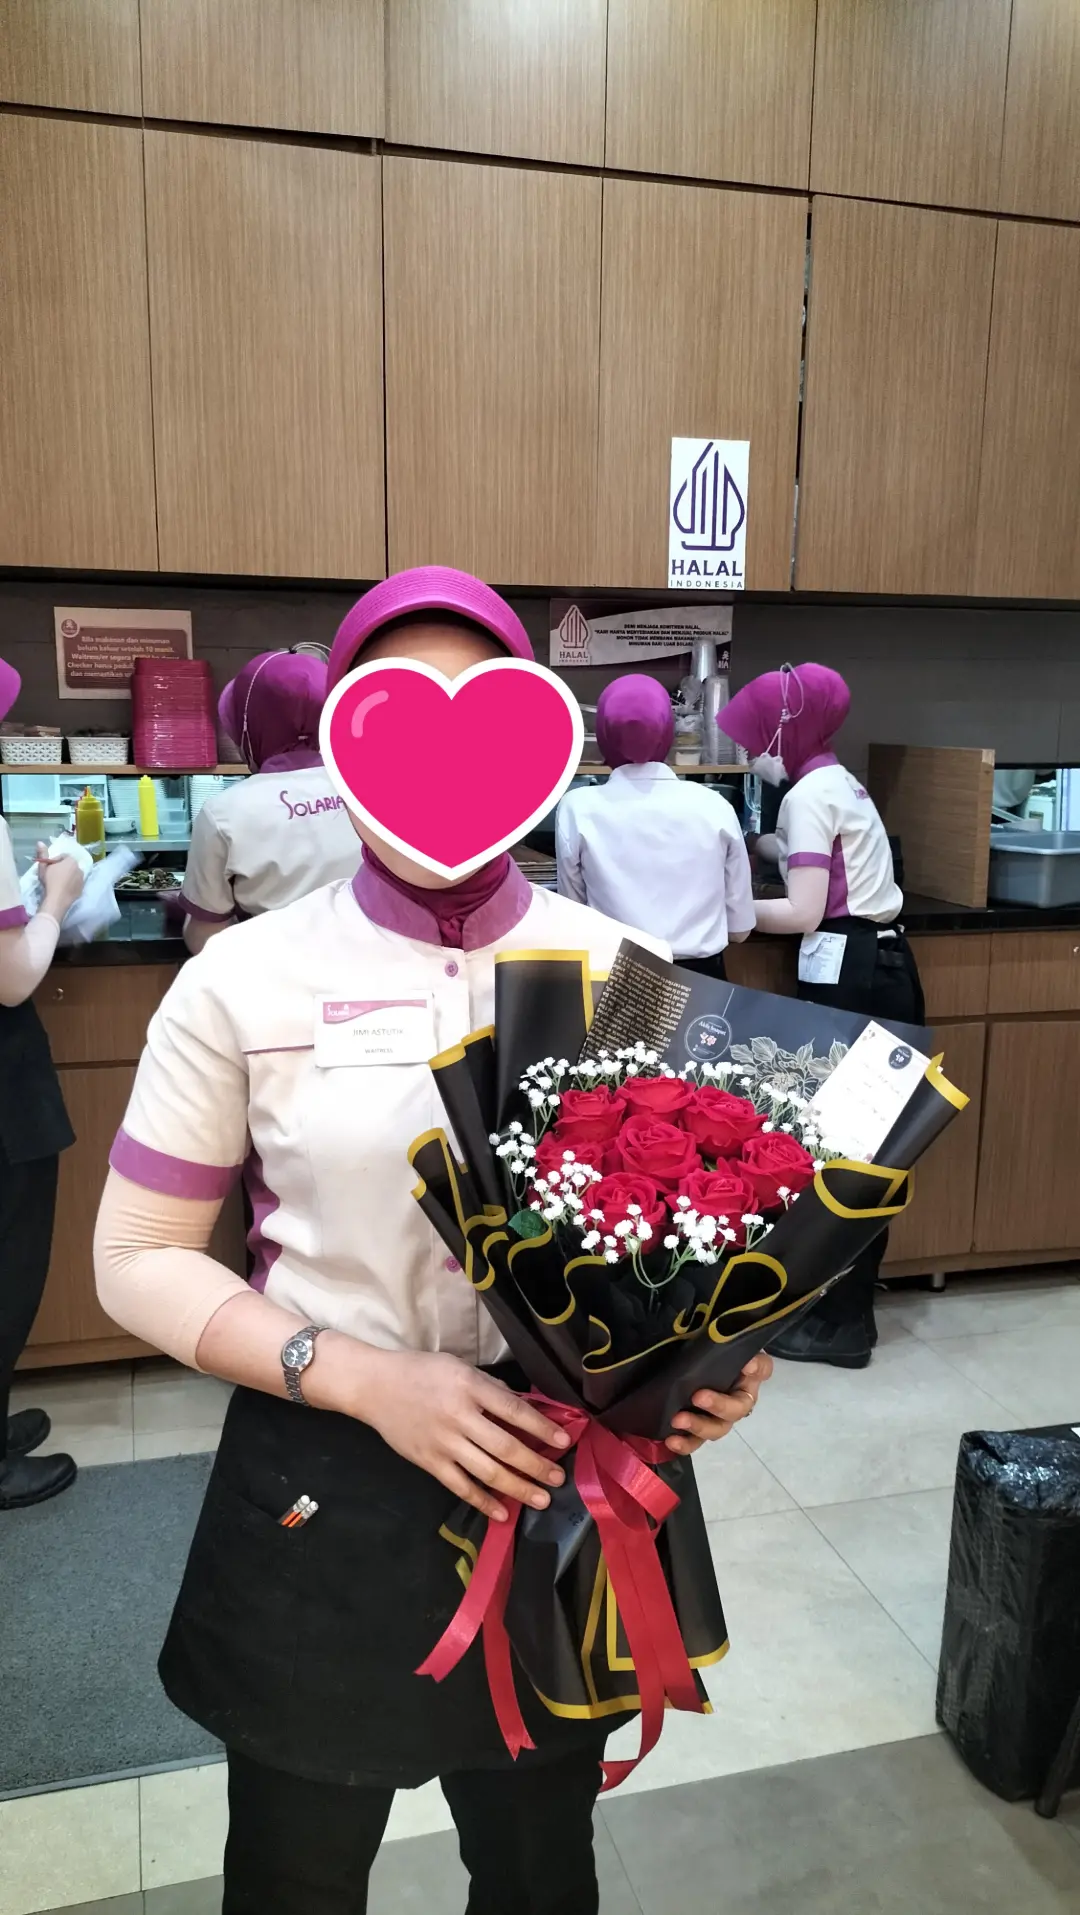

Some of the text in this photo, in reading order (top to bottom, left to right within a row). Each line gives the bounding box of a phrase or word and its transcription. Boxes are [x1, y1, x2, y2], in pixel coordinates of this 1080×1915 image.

[671, 559, 742, 576] HALAL
[670, 580, 742, 588] INDONESIA
[559, 651, 589, 659] HALAL
